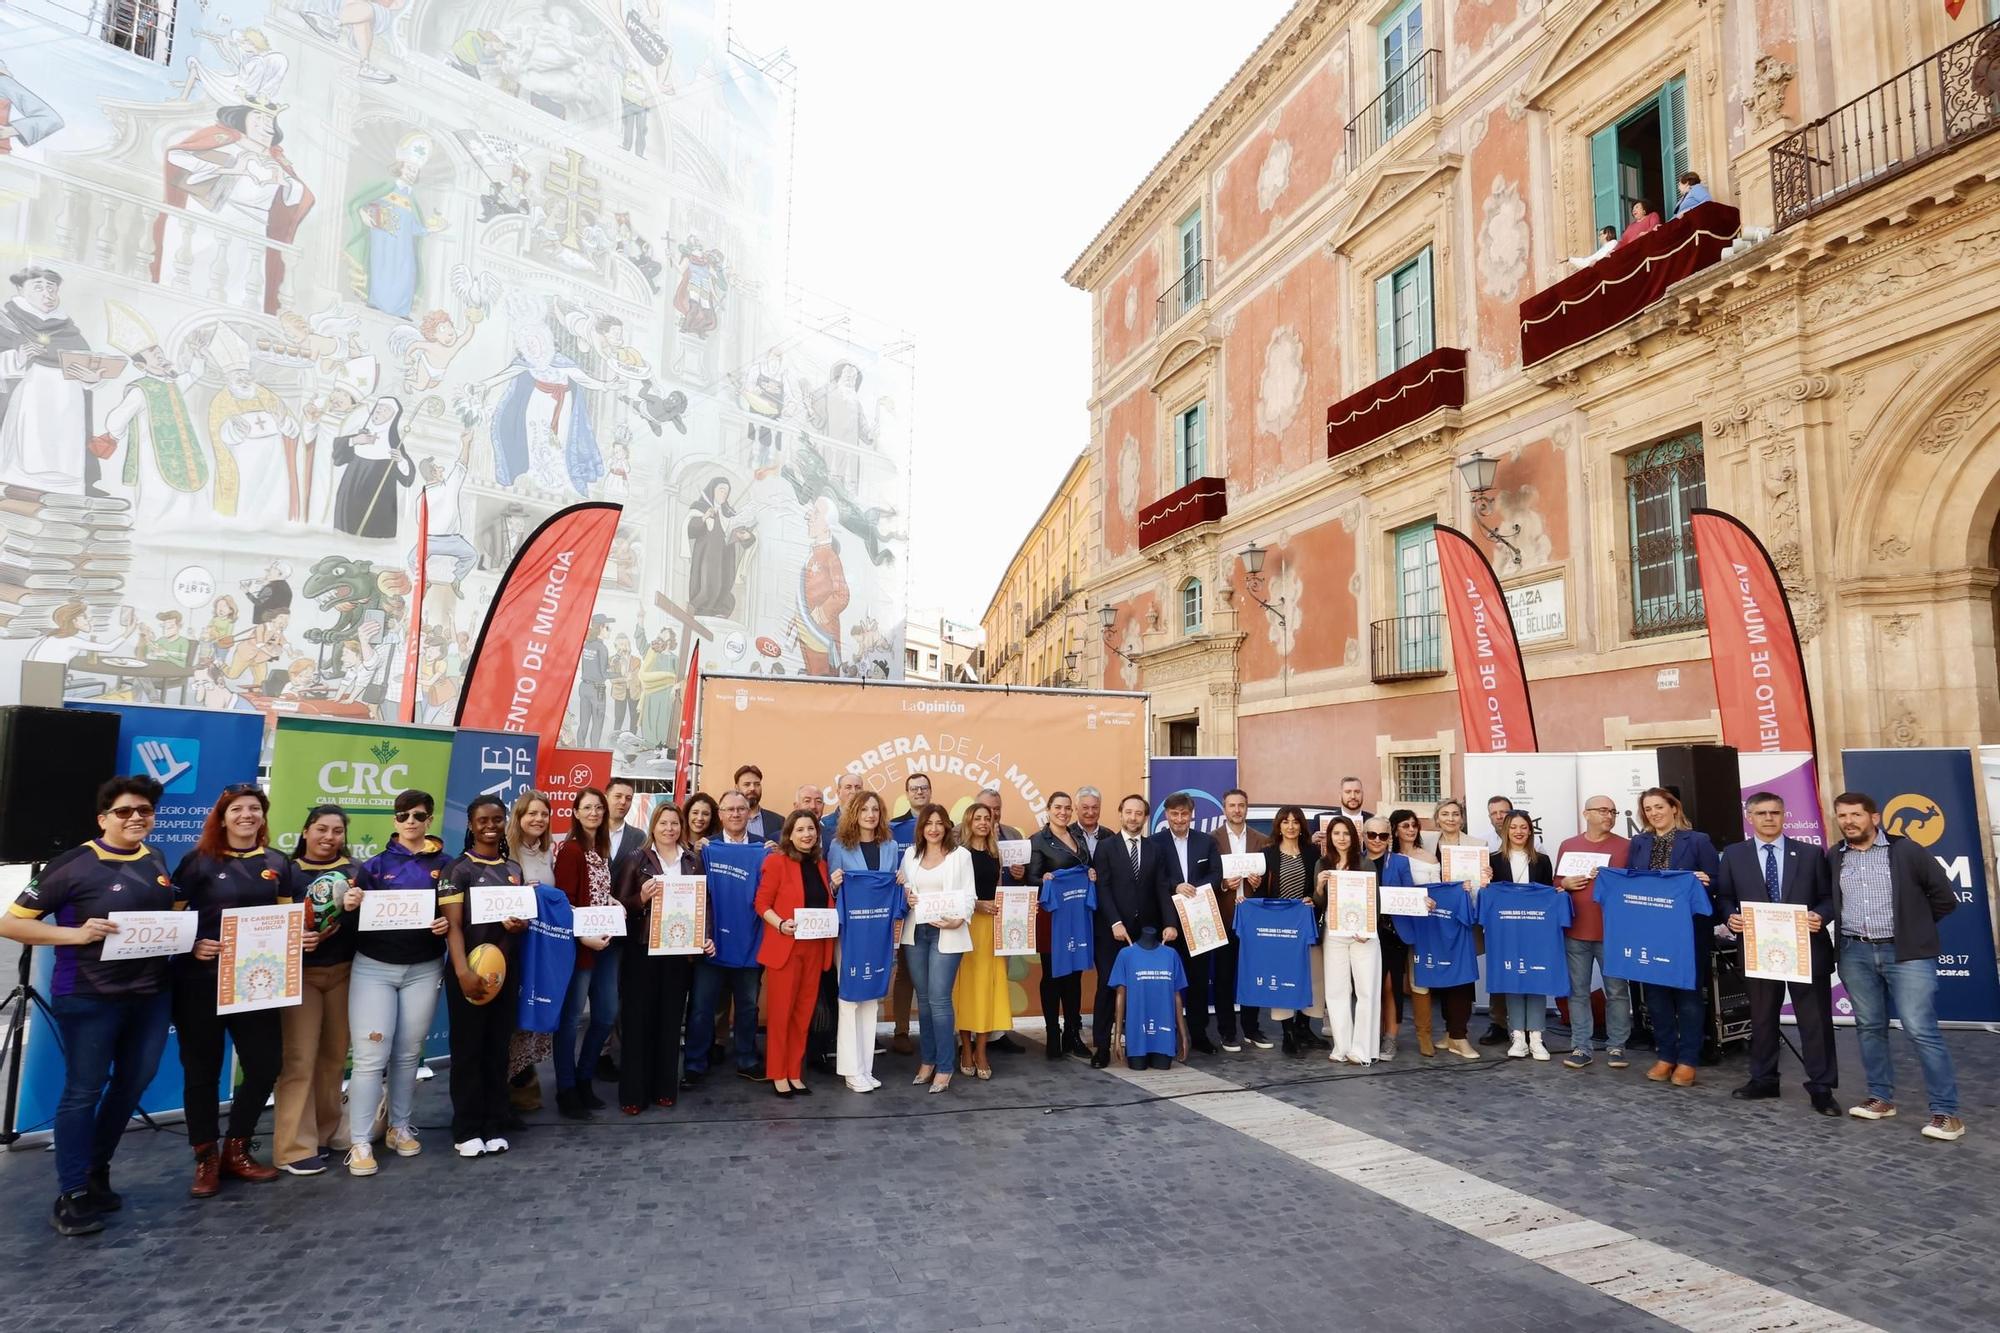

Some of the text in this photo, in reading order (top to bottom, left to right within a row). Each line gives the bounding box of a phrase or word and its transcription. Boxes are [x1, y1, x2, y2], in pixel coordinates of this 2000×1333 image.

[532, 550, 575, 637] MURCIA
[1505, 589, 1542, 608] PLAZA
[1512, 607, 1534, 619] DEL
[1526, 612, 1562, 634] BELLUGA
[522, 640, 547, 672] DE
[515, 747, 532, 776] FP
[822, 733, 931, 806] CRRERA
[938, 733, 972, 756] DE
[975, 743, 1002, 771] LA
[867, 754, 1002, 794] DE MURCIA
[317, 760, 409, 796] CRC
[549, 775, 565, 785] un
[315, 796, 337, 805] CAJA
[338, 797, 368, 805] RURAL
[149, 834, 165, 843] DE
[1232, 860, 1258, 870] 2024
[484, 896, 524, 912] 2024
[925, 899, 955, 913] 2024
[1390, 896, 1419, 907] 2024
[375, 901, 420, 918] 2024
[250, 914, 286, 923] CARRERA
[583, 914, 615, 927] 2024
[803, 918, 831, 930] 2024
[123, 926, 179, 944] 2024
[253, 924, 283, 932] MURCIA
[1956, 954, 1969, 965] 17
